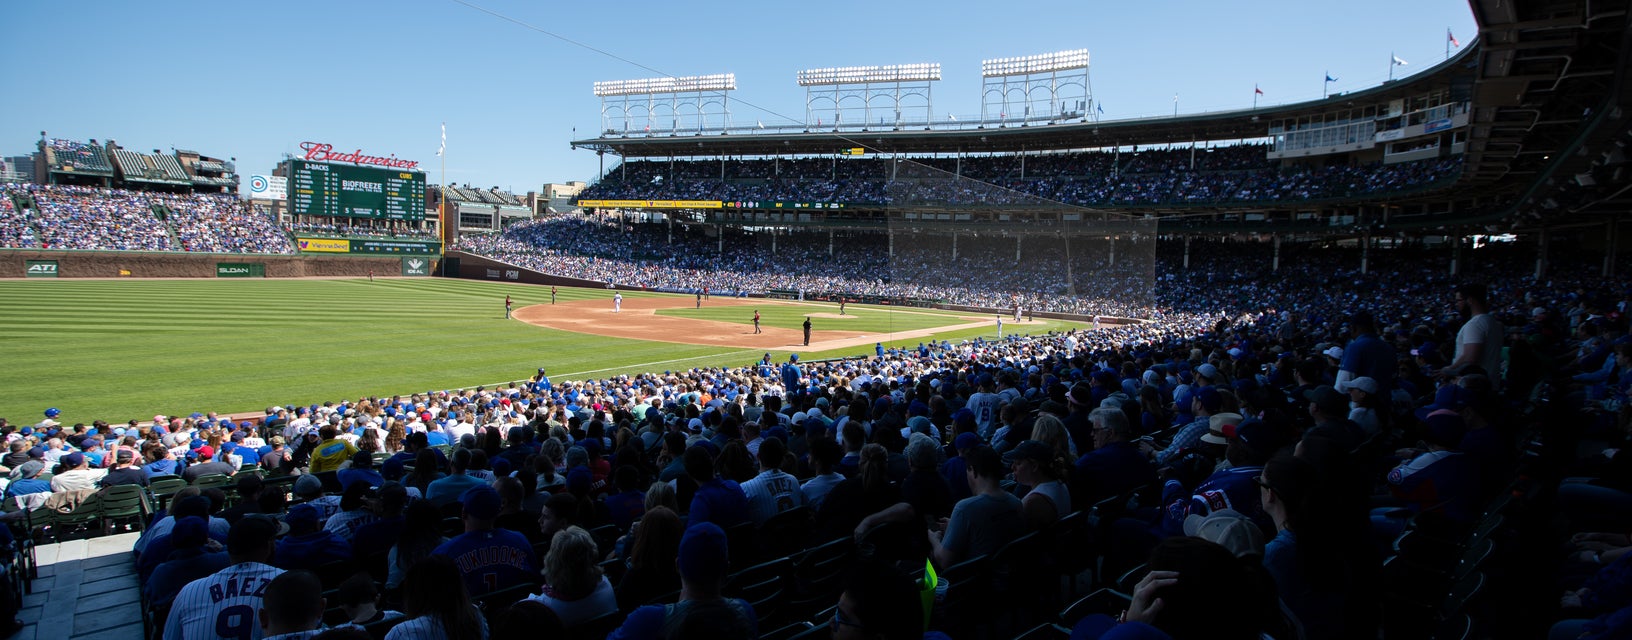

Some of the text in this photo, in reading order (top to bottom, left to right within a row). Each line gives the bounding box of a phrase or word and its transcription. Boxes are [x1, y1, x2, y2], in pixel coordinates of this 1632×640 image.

[300, 142, 418, 168] Budweiser
[399, 172, 413, 180] CUBS
[981, 408, 990, 422] 9
[209, 572, 272, 604] BÁEZ
